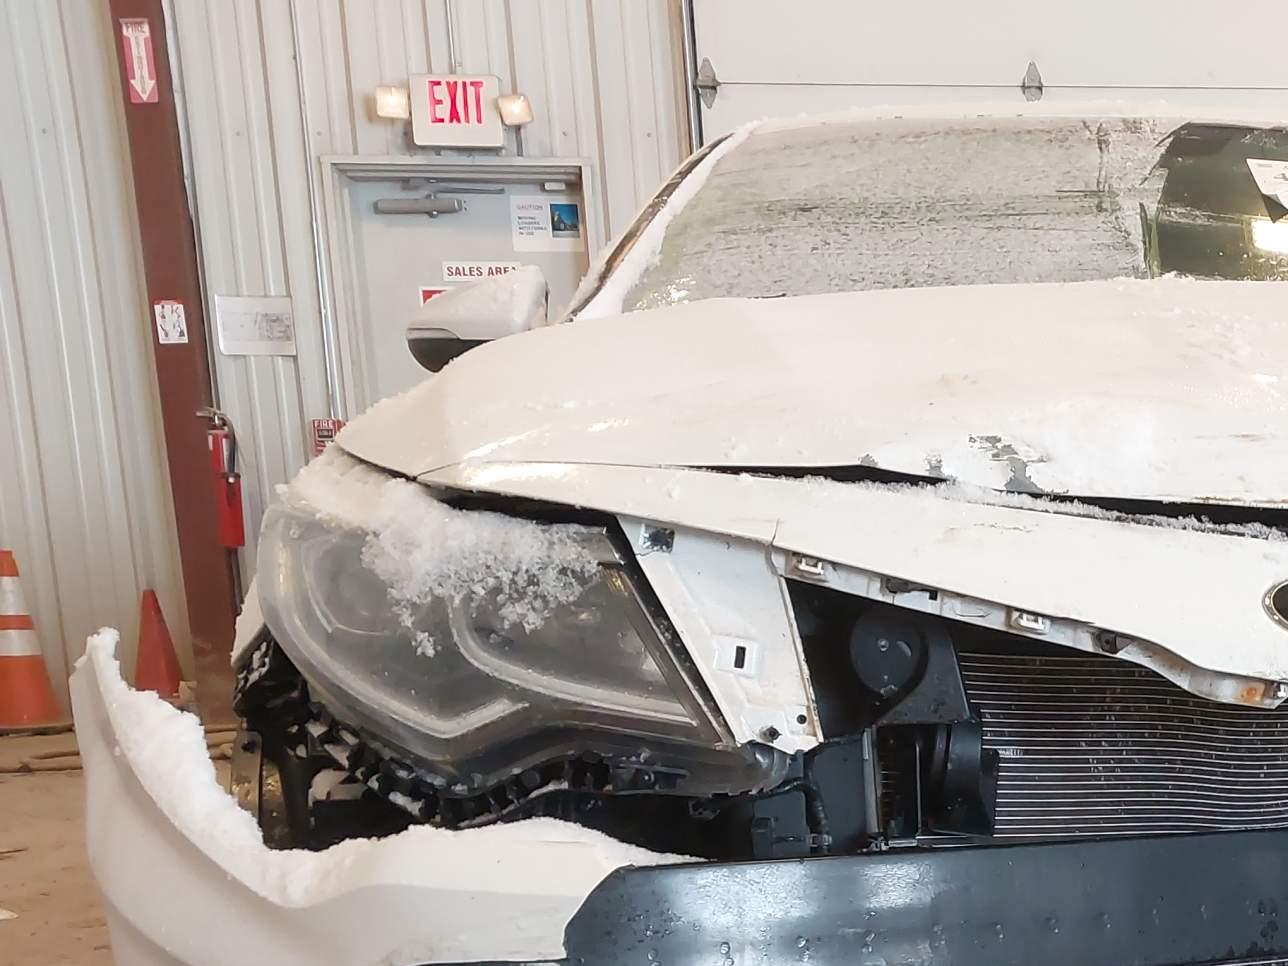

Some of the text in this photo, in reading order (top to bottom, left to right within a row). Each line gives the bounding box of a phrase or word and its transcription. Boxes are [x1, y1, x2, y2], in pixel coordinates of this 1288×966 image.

[427, 80, 484, 124] EXIT
[446, 266, 483, 277] SALES
[314, 419, 333, 429] FIRE
